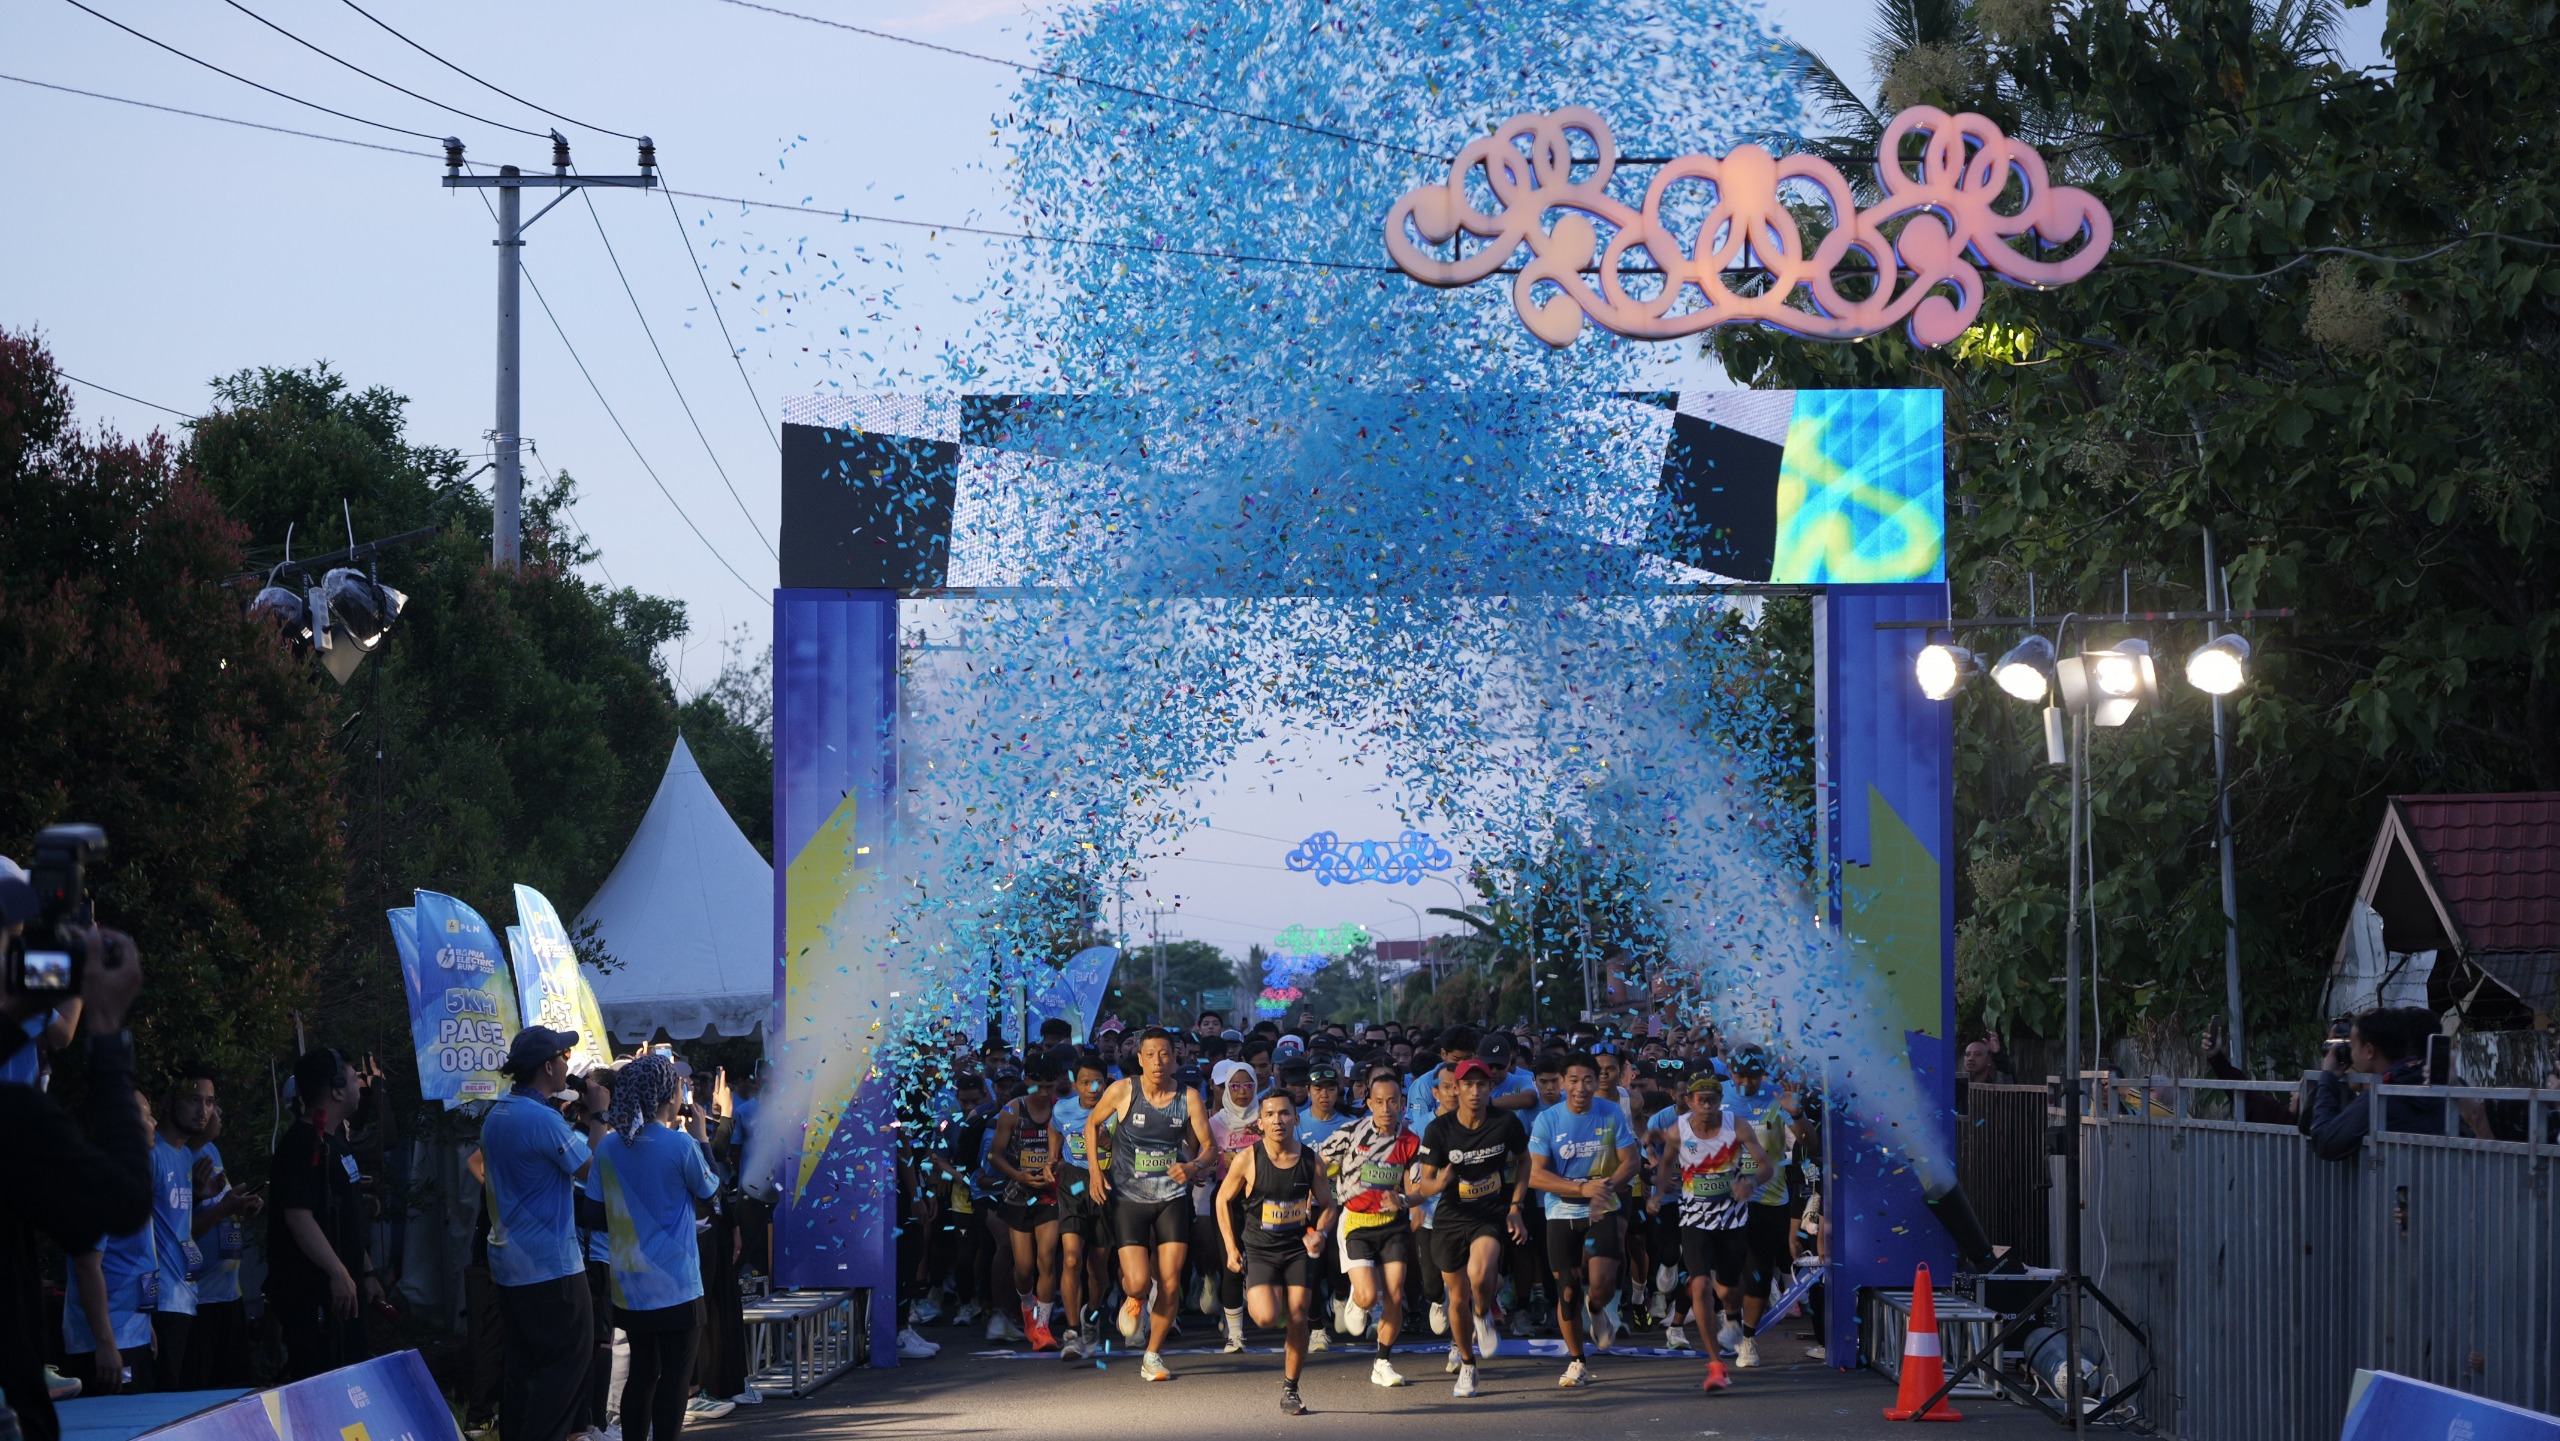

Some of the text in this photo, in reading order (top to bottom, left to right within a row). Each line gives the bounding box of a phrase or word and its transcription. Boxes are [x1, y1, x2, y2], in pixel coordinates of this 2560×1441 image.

[460, 923, 480, 933] PLN
[456, 949, 485, 959] BANUA
[456, 957, 495, 966] ELECTRIC
[446, 987, 498, 1016] 5KM
[440, 1018, 506, 1046] PACE
[1467, 1181, 1495, 1195] 10197
[1699, 1180, 1730, 1191] 12081
